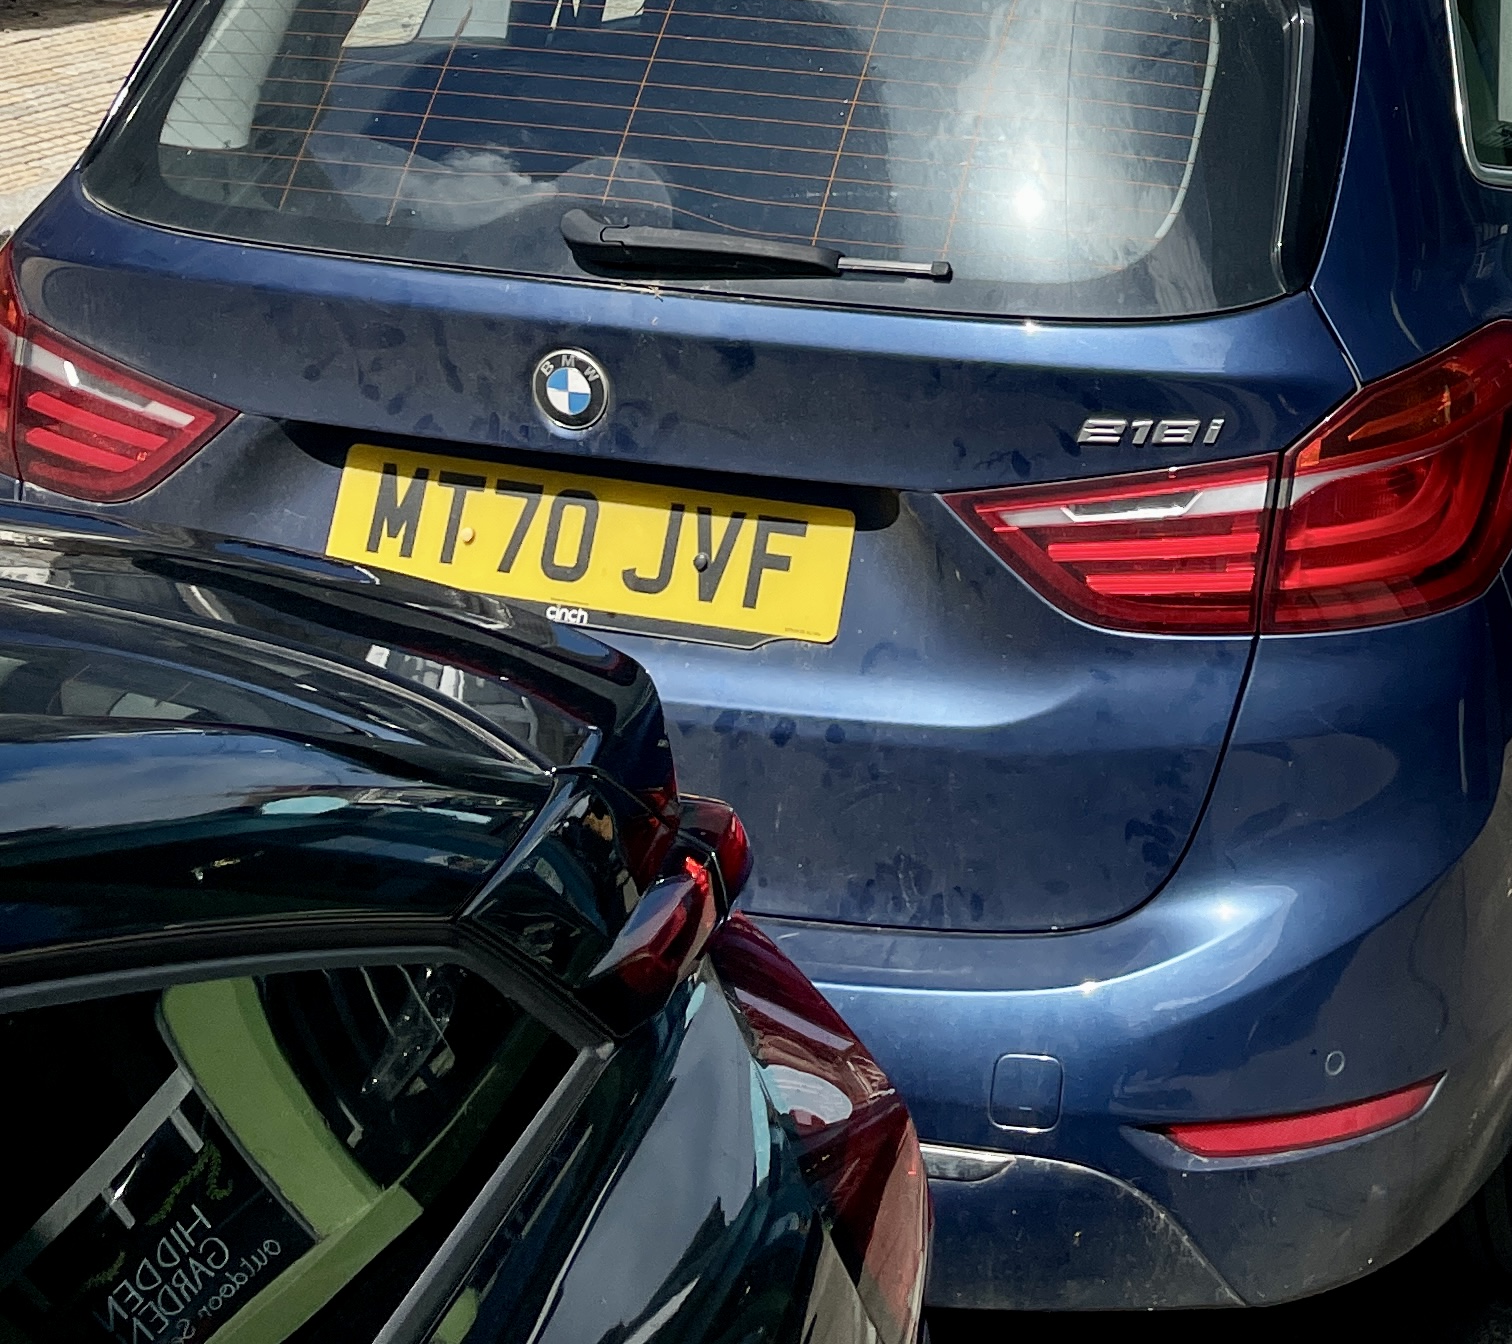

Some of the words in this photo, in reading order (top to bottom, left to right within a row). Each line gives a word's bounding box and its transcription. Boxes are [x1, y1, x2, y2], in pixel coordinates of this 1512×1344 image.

[540, 354, 600, 382] BMW
[1077, 418, 1225, 445] 218i
[366, 461, 600, 583] MT70
[621, 502, 809, 609] JVF
[545, 603, 589, 624] cinch
